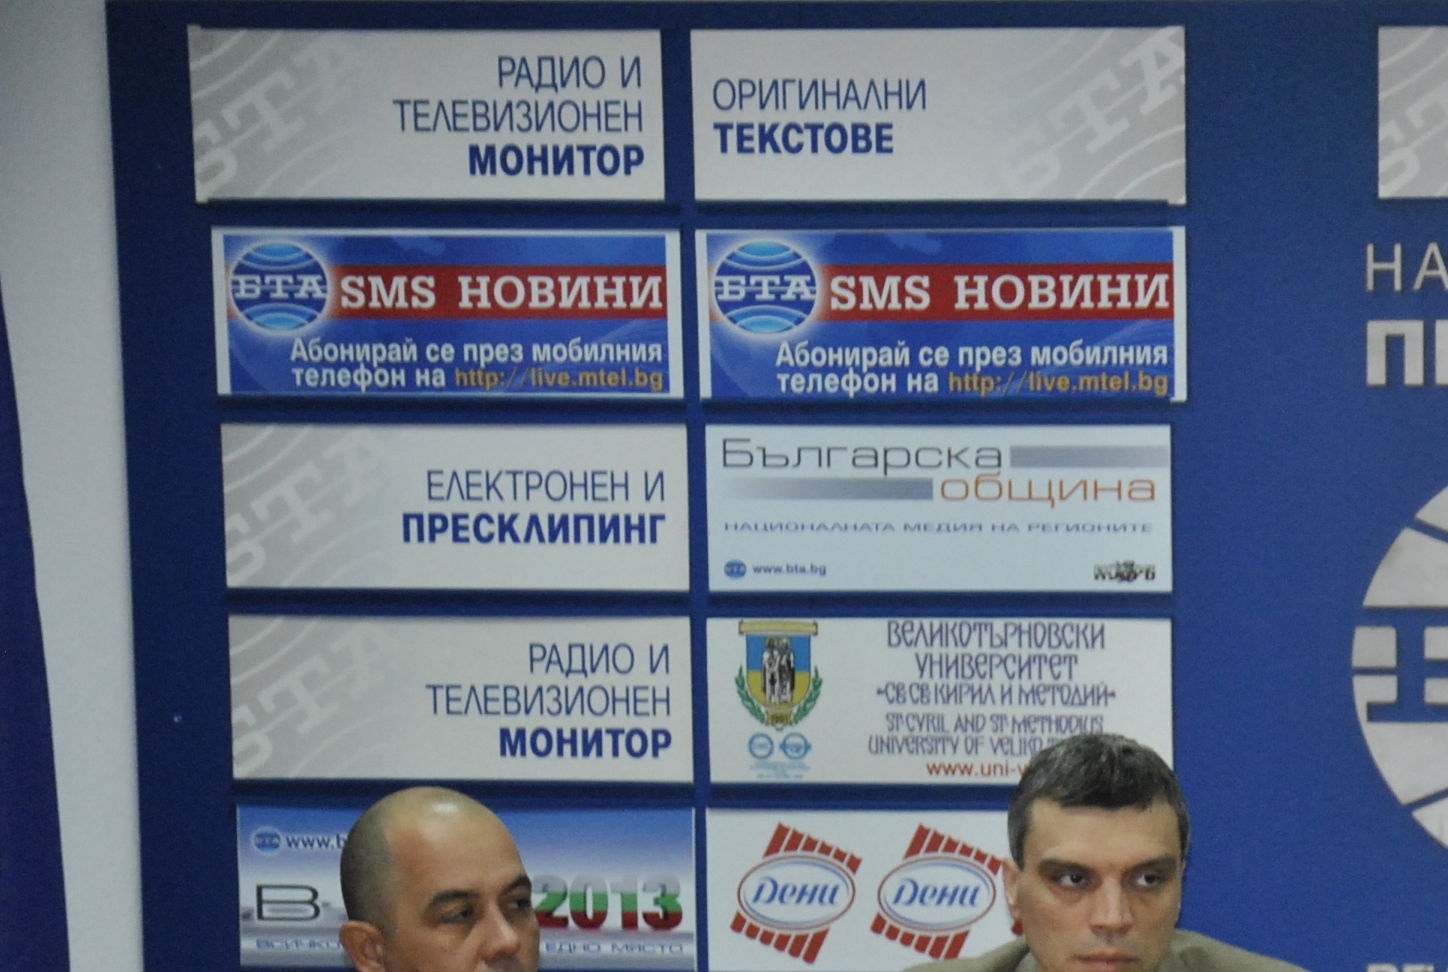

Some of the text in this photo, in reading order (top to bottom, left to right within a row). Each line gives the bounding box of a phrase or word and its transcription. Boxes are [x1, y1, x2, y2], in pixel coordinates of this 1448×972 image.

[498, 56, 641, 92] РАДИО И
[712, 78, 927, 111] ОРИГИНАЛНИ
[393, 100, 642, 132] ТЕЛЕВИЗИОНЕН
[712, 122, 894, 154] ТЕКСТОВЕ
[469, 145, 645, 176] МОНИТОР
[231, 274, 663, 309] БТА SMS НОВИНИ
[716, 274, 1170, 310] БТА SMS НОВИНИ
[290, 338, 663, 369] Абонирай се през мобилния
[775, 340, 1168, 372] Абонирай се през мобилния
[291, 363, 664, 394] телефон на http://live.mtel.bg
[776, 368, 1169, 398] телефон на http://live.mtel.bg
[721, 438, 1002, 476] Българска
[427, 470, 665, 502] ЕЛЕКТРОНЕН И
[940, 471, 1155, 508] община
[402, 513, 666, 544] ПРЕСКЛИПИНГ
[724, 521, 1154, 534] НАЦИОНАЛНАТА МЕДИЯ НА РЕГИОНИТЕ
[752, 562, 827, 577] www.bta.bg
[887, 620, 1105, 650] ВЕЛИКОТЪРНОВСКИ
[529, 643, 669, 678] РАДИО И
[915, 652, 1078, 681] УНИВЕРСИТЕТ
[426, 685, 671, 717] ТЕЛЕВИЗИОНЕН
[934, 682, 996, 705] КИРИЛ
[1000, 683, 1013, 706] И
[953, 712, 986, 733] AND
[500, 728, 672, 758] МОНИТОР
[868, 735, 959, 756] UNIVERSITY
[964, 736, 984, 756] OF
[927, 760, 1031, 777] www.uni-v
[285, 832, 346, 850] www.b
[532, 873, 684, 931] 2013
